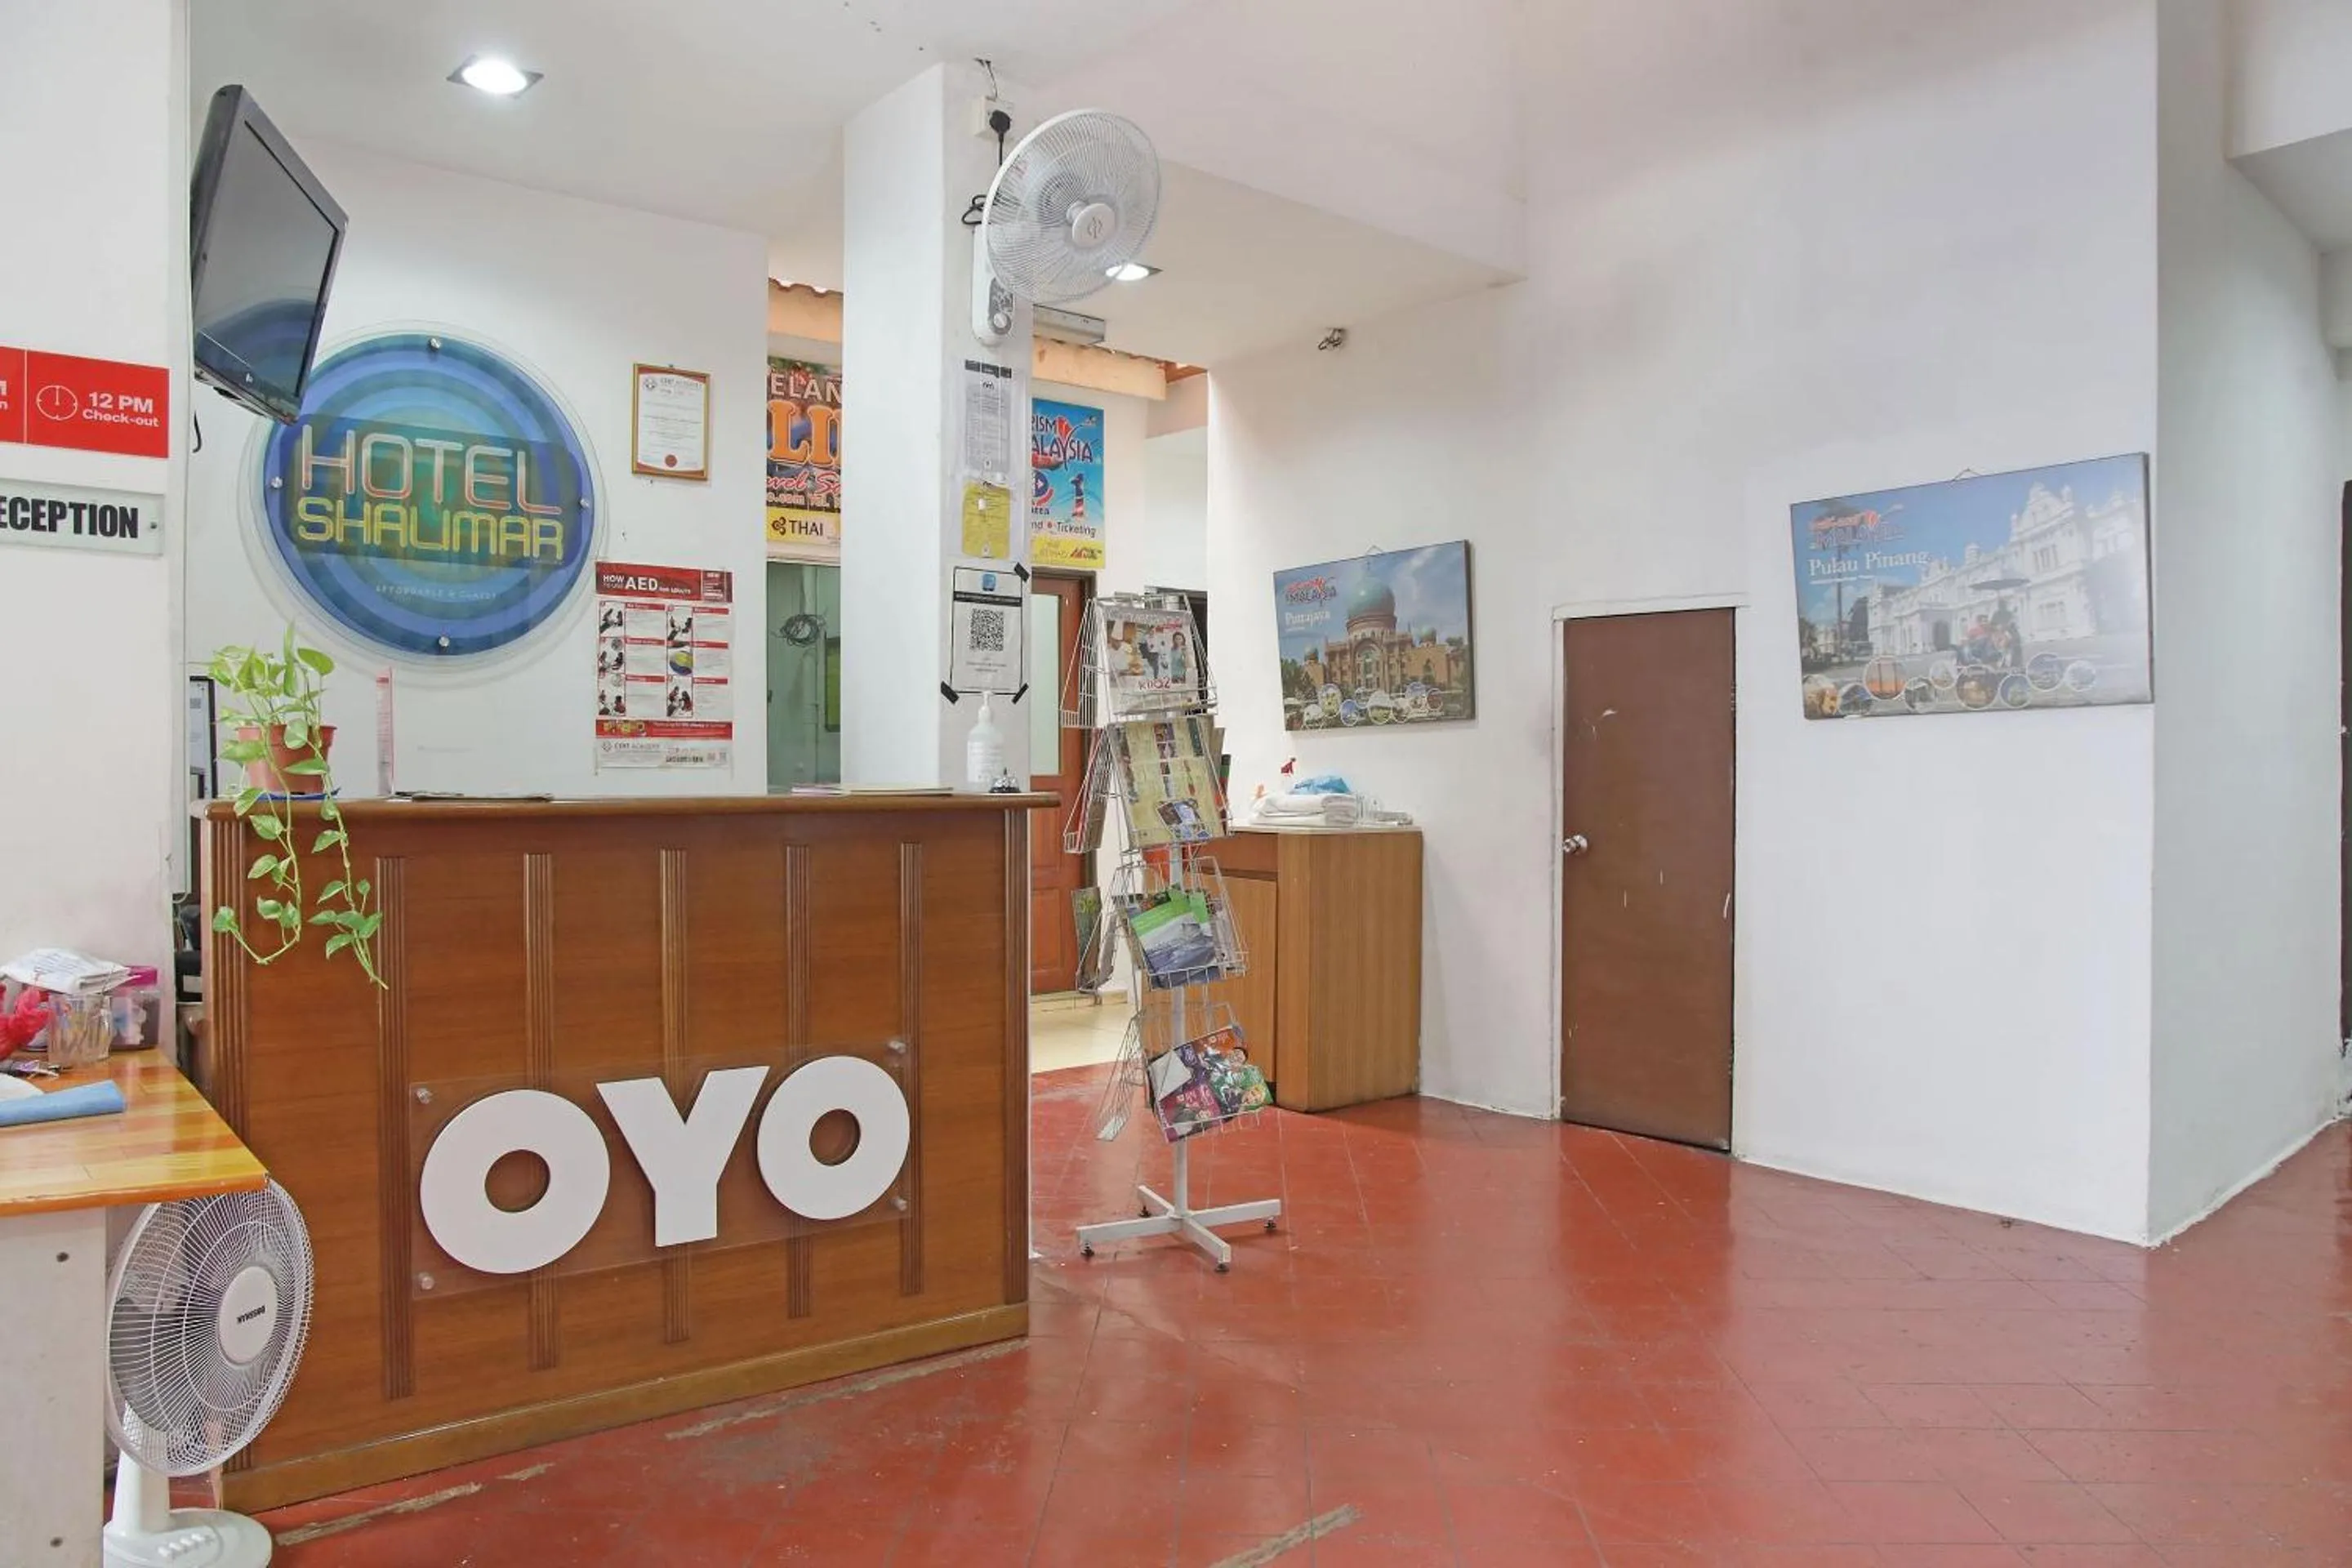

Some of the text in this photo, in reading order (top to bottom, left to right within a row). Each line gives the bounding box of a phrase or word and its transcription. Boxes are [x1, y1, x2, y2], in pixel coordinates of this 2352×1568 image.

[89, 391, 154, 413] 12 PM
[82, 408, 160, 427] Check-out
[301, 424, 562, 514] HOTEL
[298, 497, 564, 560] SHALIMAR
[789, 519, 823, 536] THAI
[1058, 522, 1095, 537] Ticketing
[1807, 550, 1929, 576] Pulau Pinang
[603, 574, 658, 591] HOW AED
[419, 1054, 911, 1274] OYO
